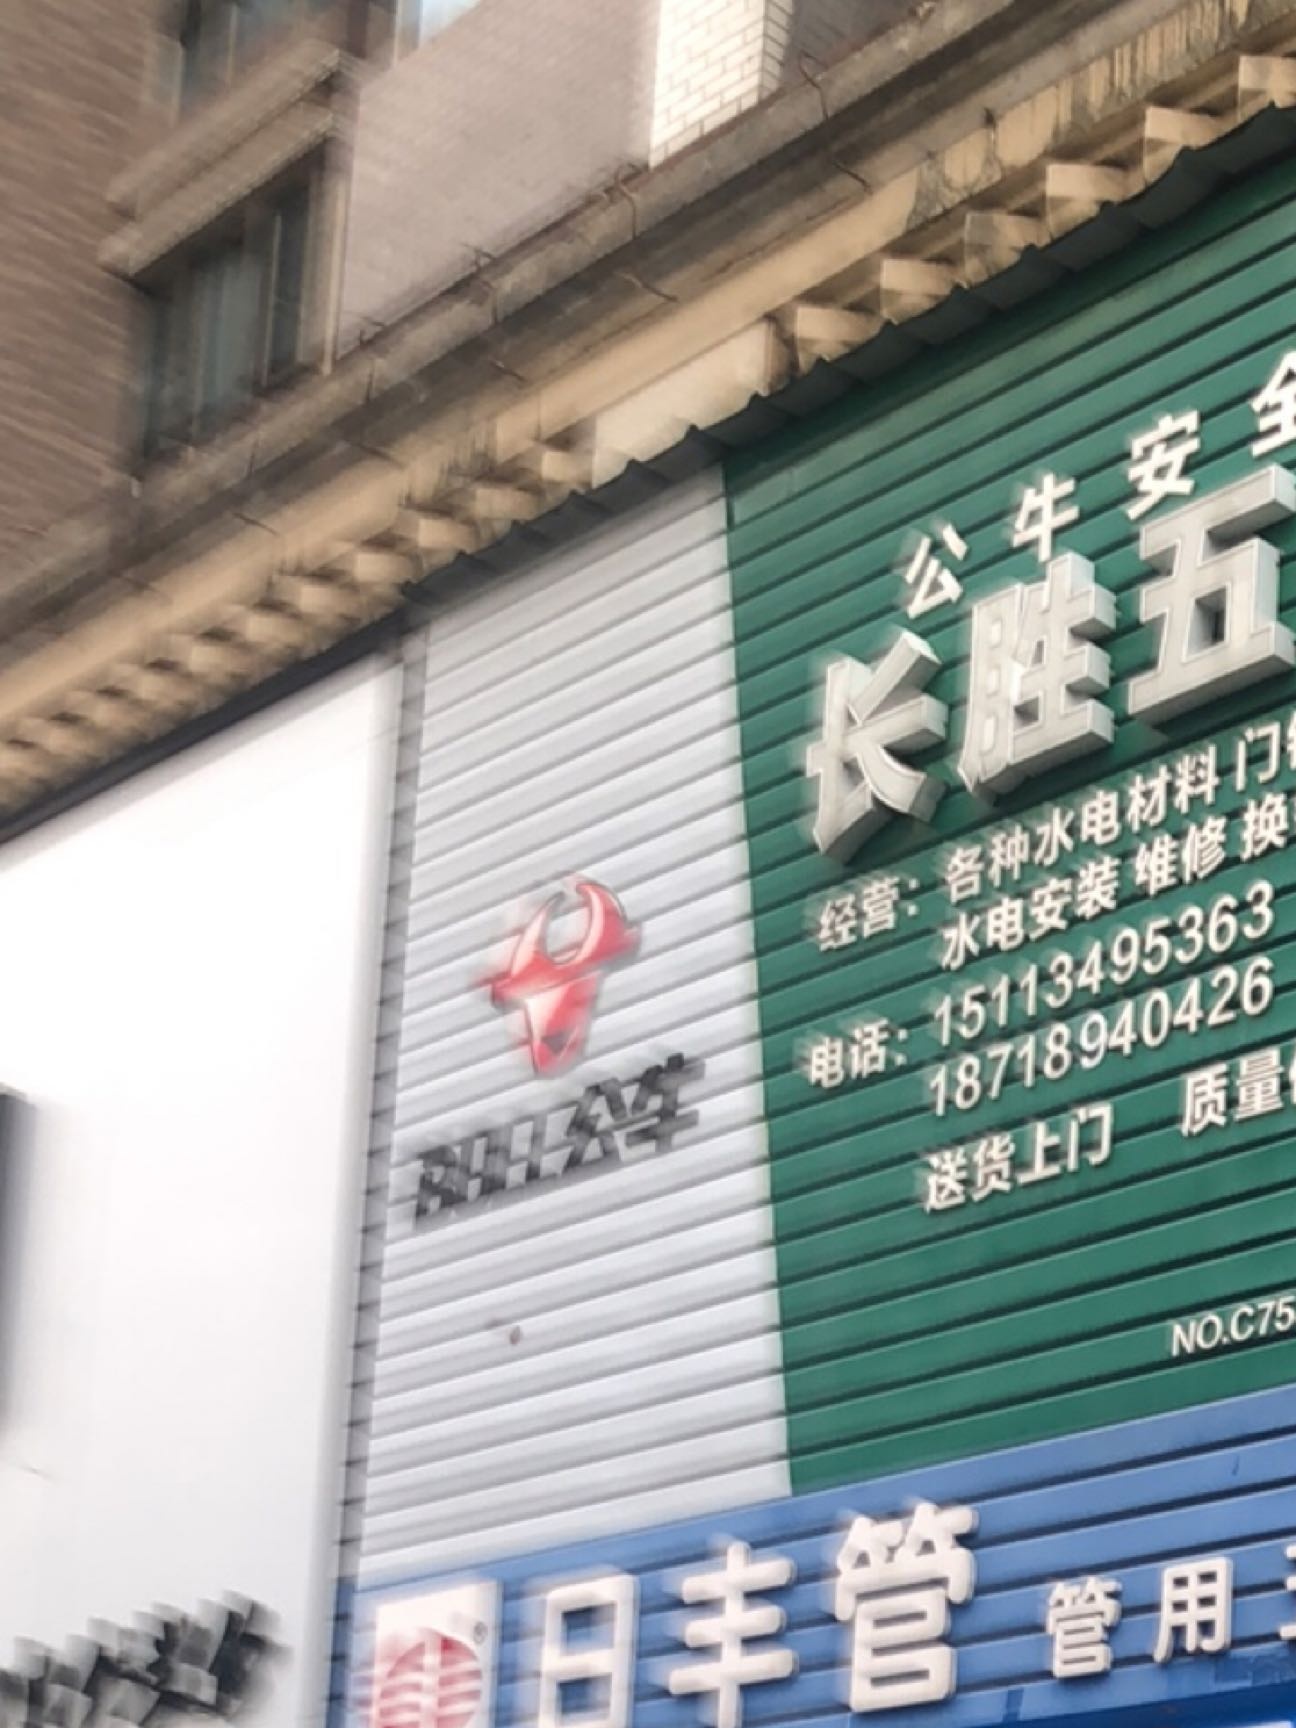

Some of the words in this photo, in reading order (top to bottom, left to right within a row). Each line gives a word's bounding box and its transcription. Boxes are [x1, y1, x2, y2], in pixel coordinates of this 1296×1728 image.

[940, 855, 1122, 971] 水电安装
[1133, 814, 1227, 897] 维修
[944, 744, 1220, 904] 各种水电材料
[927, 954, 1274, 1118] 18718940426
[933, 879, 1276, 1047] 15113495363
[923, 1101, 1114, 1214] 送货上门
